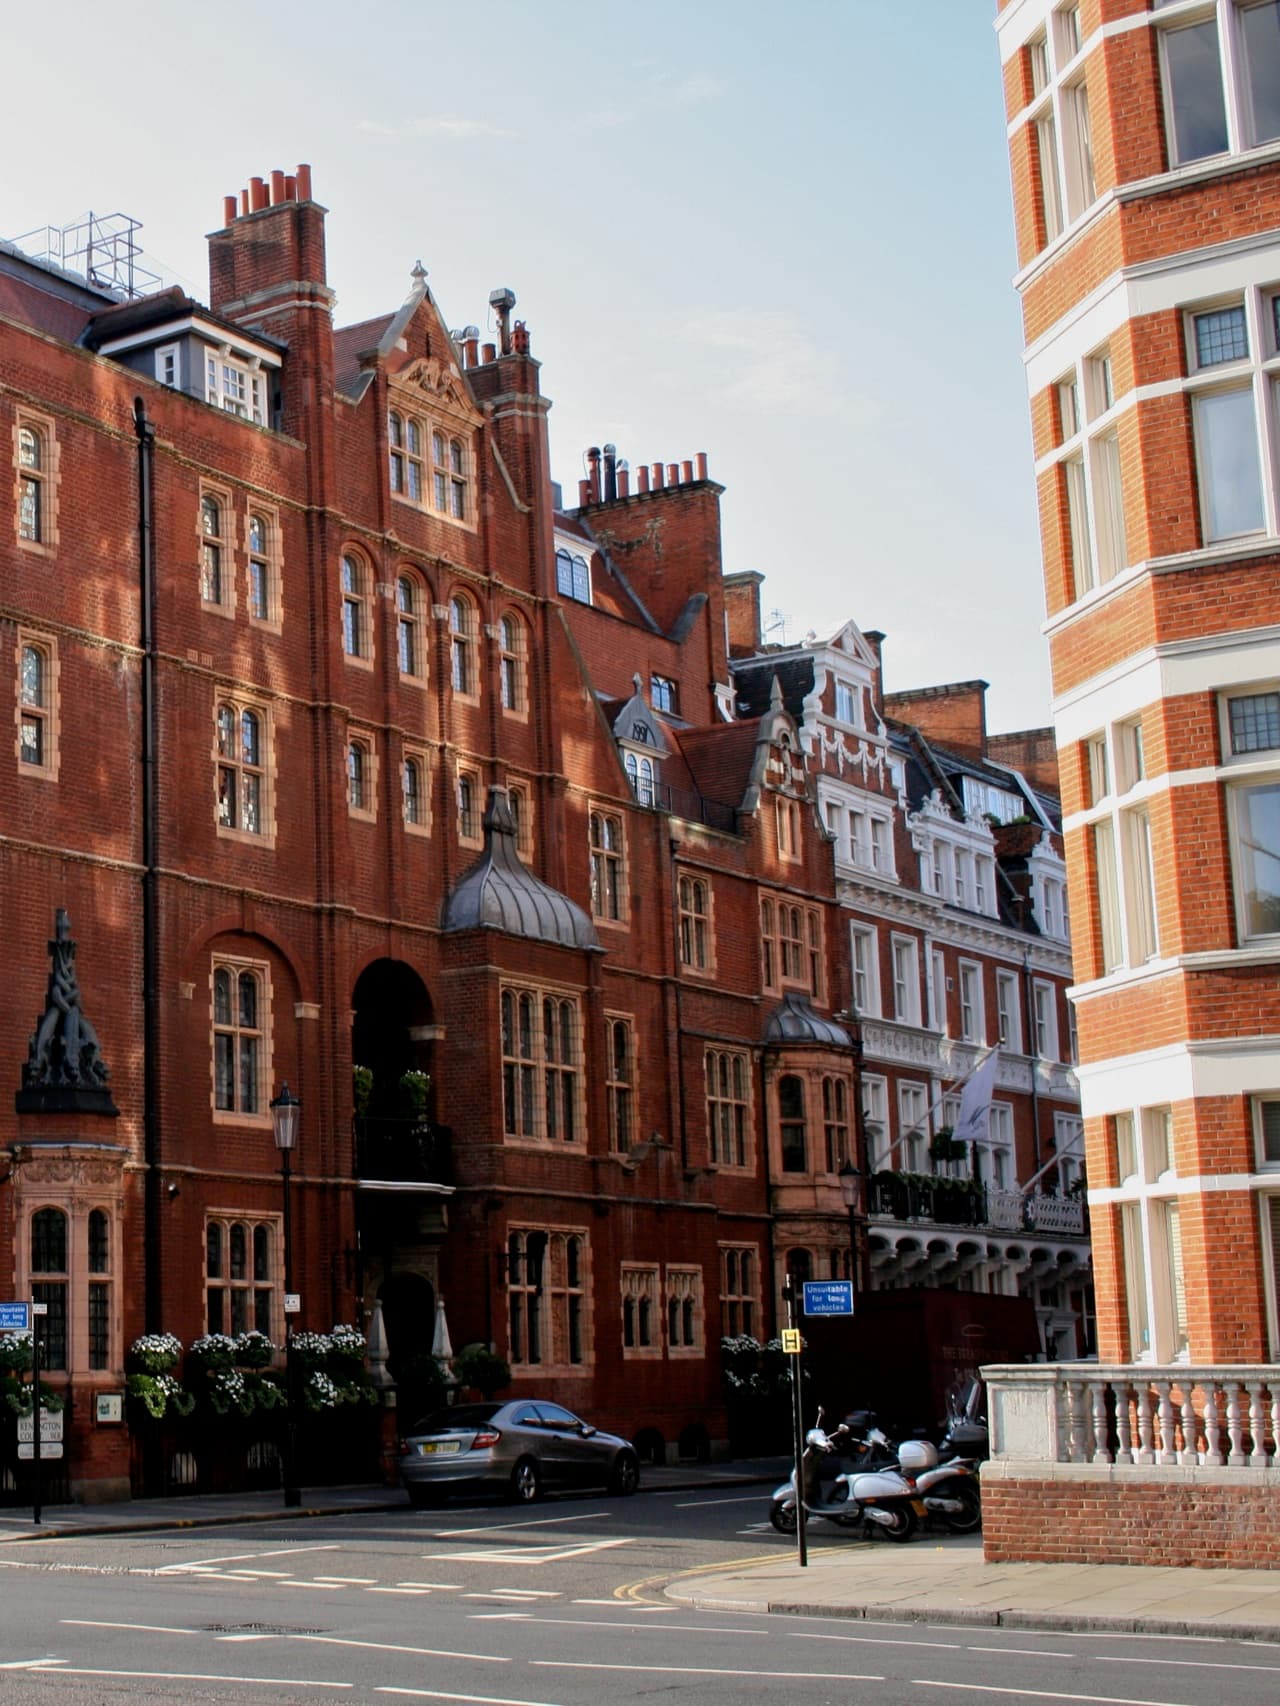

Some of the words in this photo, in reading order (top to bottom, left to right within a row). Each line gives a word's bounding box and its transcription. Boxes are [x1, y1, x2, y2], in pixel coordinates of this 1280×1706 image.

[807, 1285, 849, 1294] Unsuitable
[812, 1294, 823, 1302] for
[827, 1294, 845, 1303] long
[813, 1303, 845, 1311] vehicles
[20, 1423, 61, 1431] KENNGTON
